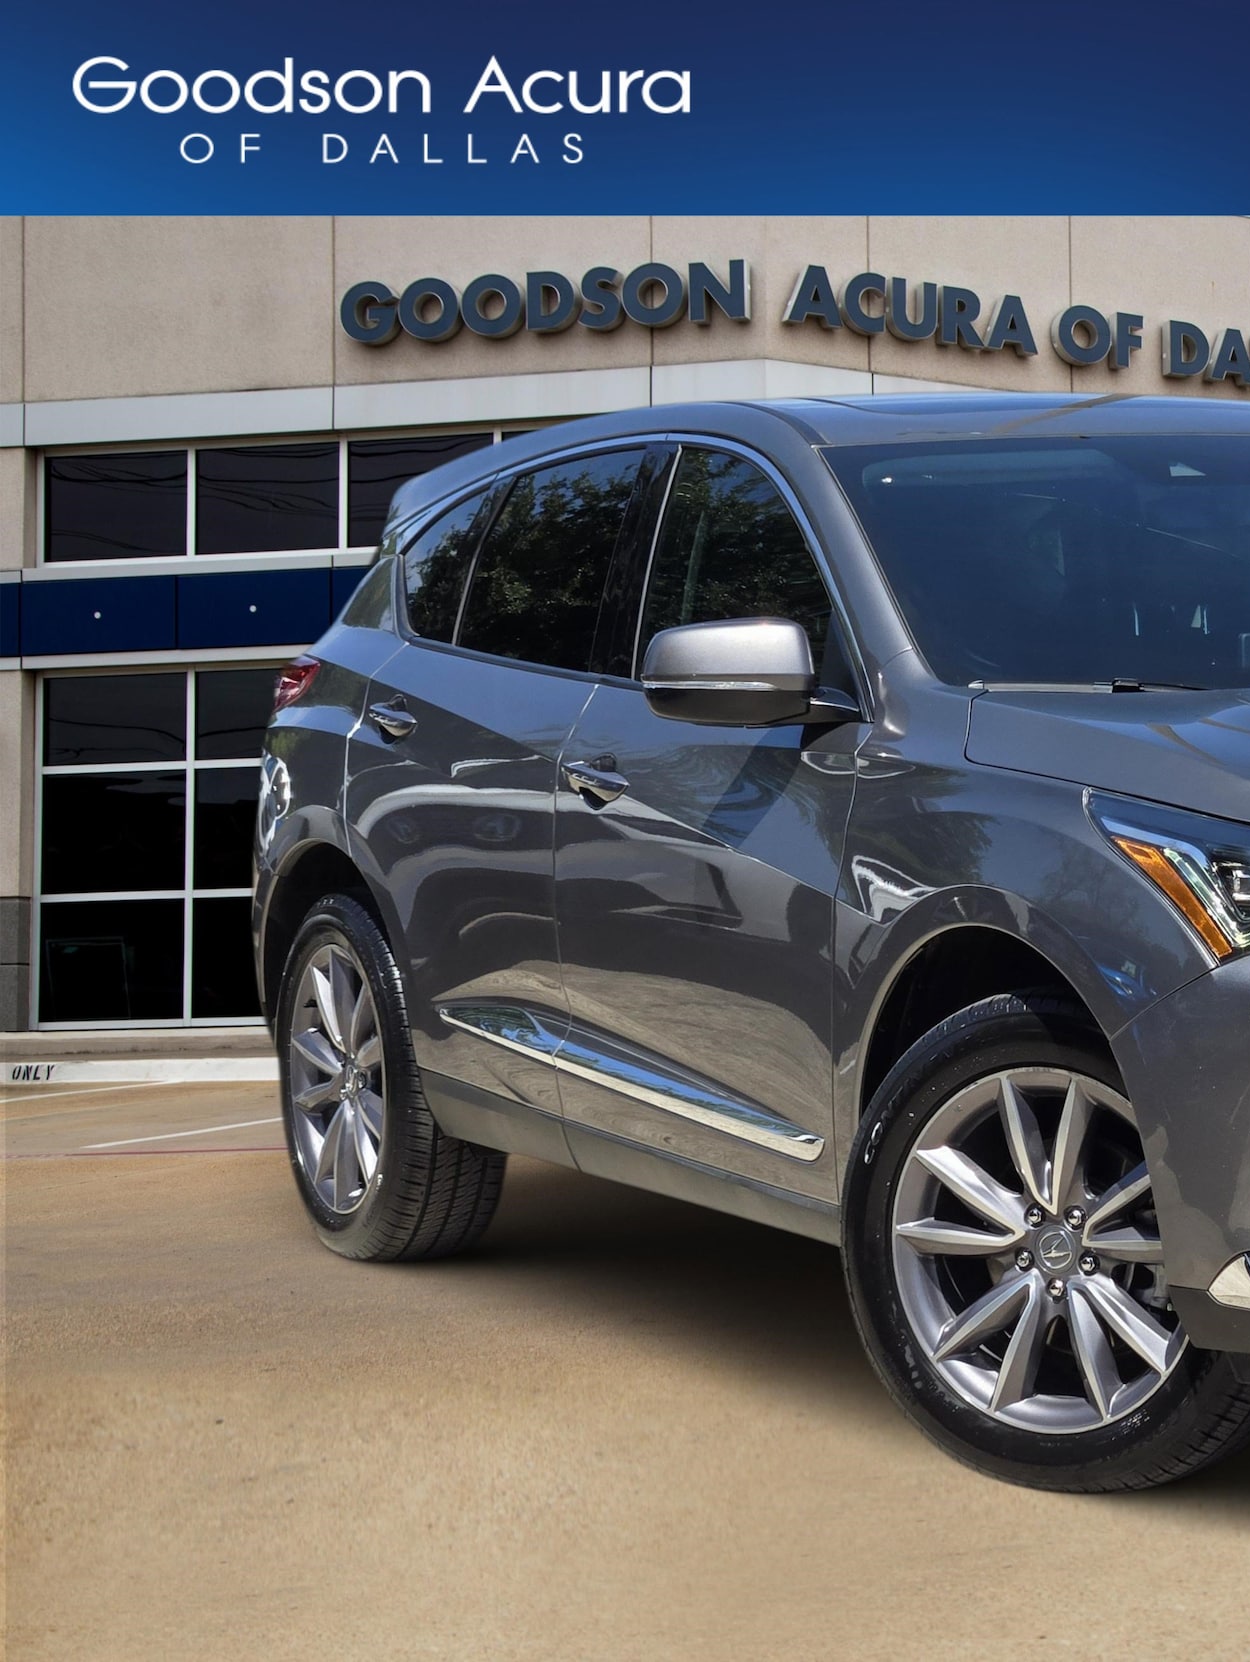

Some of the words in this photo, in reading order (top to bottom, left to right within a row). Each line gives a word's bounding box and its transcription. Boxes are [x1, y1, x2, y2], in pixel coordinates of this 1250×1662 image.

[340, 259, 750, 346] GOODSON
[783, 264, 1038, 357] ACURA
[1050, 304, 1144, 368] OF
[12, 1064, 55, 1081] ONLY
